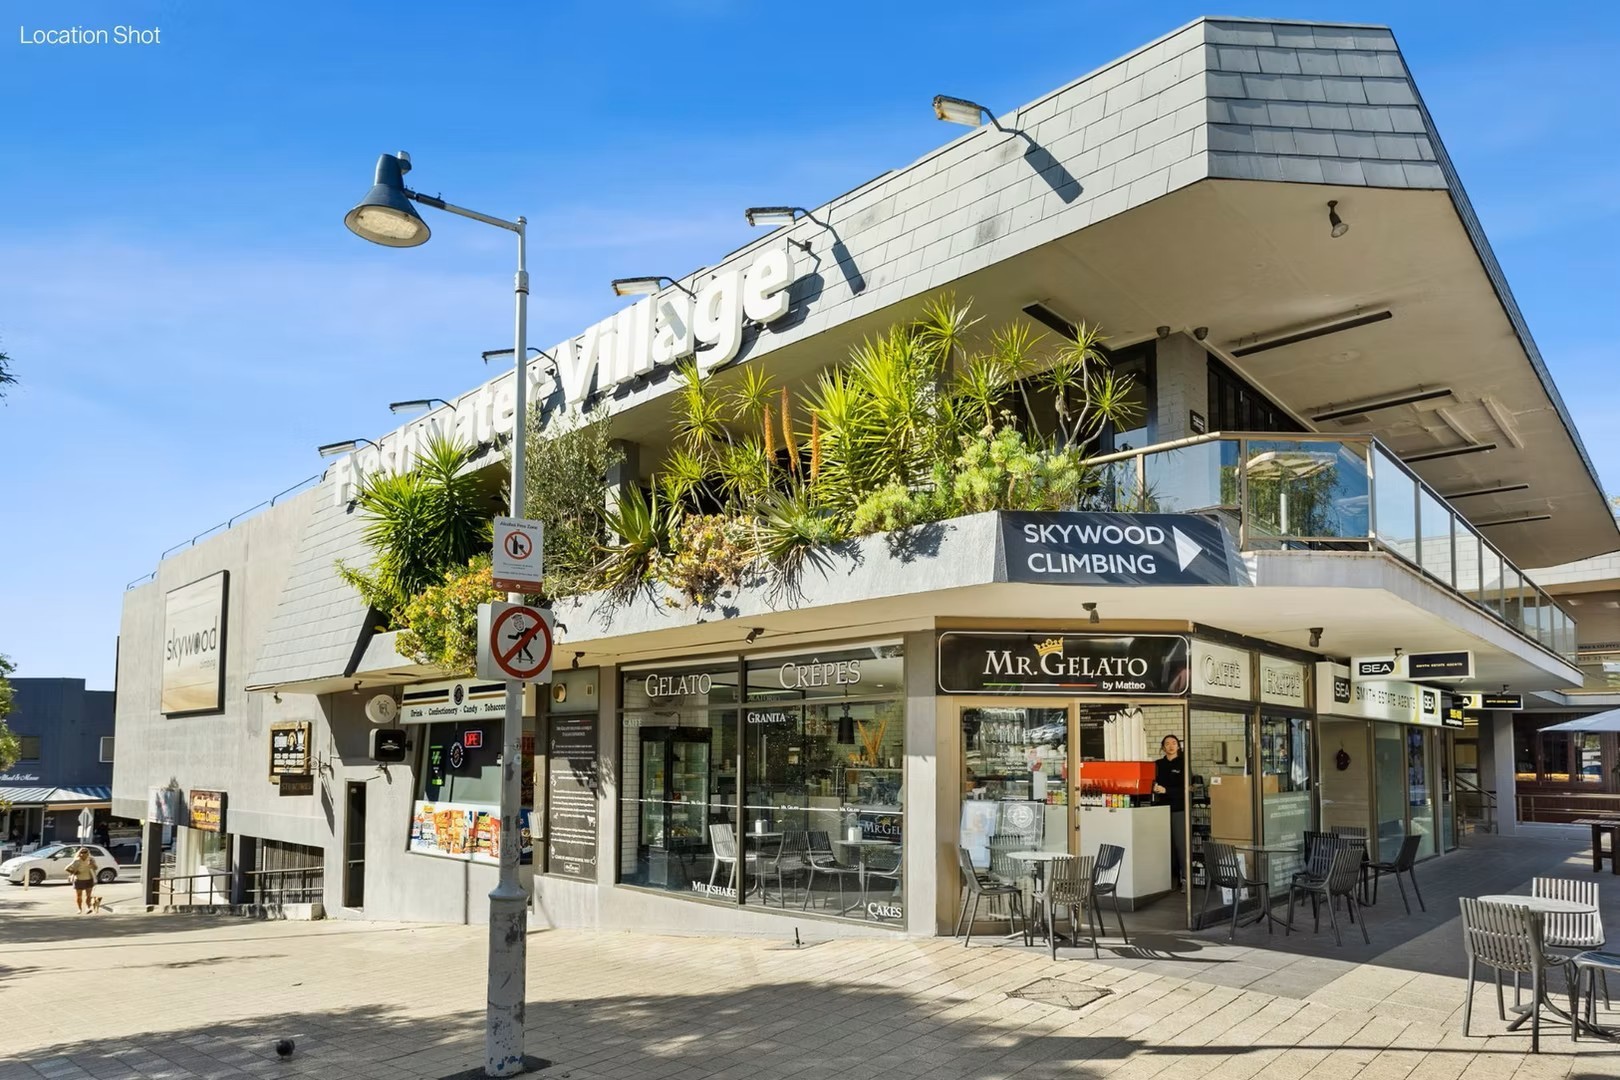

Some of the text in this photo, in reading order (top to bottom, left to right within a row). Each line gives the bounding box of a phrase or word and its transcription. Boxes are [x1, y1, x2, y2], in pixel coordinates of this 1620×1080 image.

[557, 247, 795, 404] Village
[1023, 523, 1165, 545] SKYWOOD
[1027, 552, 1157, 574] CLIMBING
[167, 615, 217, 667] skywood
[1040, 650, 1149, 679] GELATO
[1361, 664, 1392, 674] SEA
[645, 673, 712, 697] GELATO
[1102, 681, 1146, 691] by Matteo
[1335, 681, 1350, 698] SEA
[410, 709, 423, 717] Drink
[463, 704, 478, 714] Candy
[1424, 695, 1435, 709] SEA
[747, 712, 786, 723] GRANITA
[692, 880, 737, 898] MILKSHAKE
[868, 902, 903, 918] CAKES
